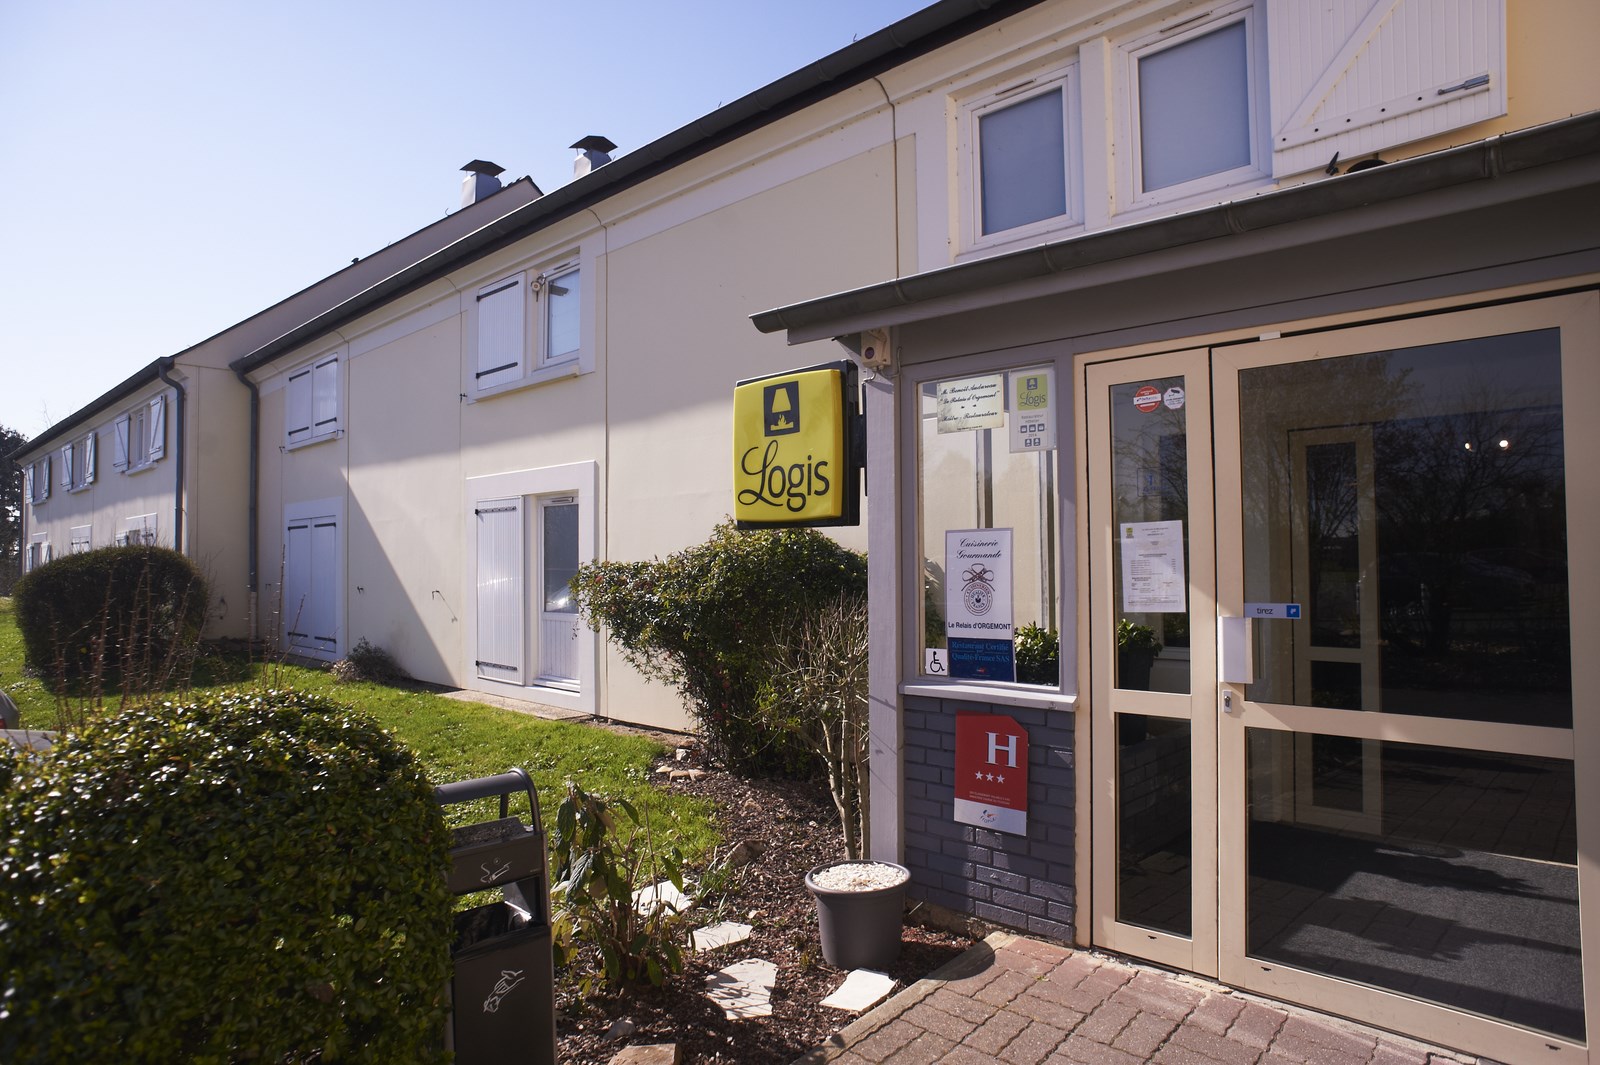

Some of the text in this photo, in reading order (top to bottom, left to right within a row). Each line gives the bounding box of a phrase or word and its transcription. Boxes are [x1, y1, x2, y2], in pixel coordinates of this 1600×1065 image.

[1019, 391, 1047, 408] Logis
[738, 440, 830, 512] Logis
[959, 538, 998, 547] Cuisinerie
[956, 550, 1002, 559] Gourmande
[956, 621, 972, 629] Relais
[972, 622, 1011, 630] d'ORGEMONT
[952, 641, 985, 650] Restaurant
[995, 655, 1010, 663] SAS
[985, 731, 1020, 768] H
